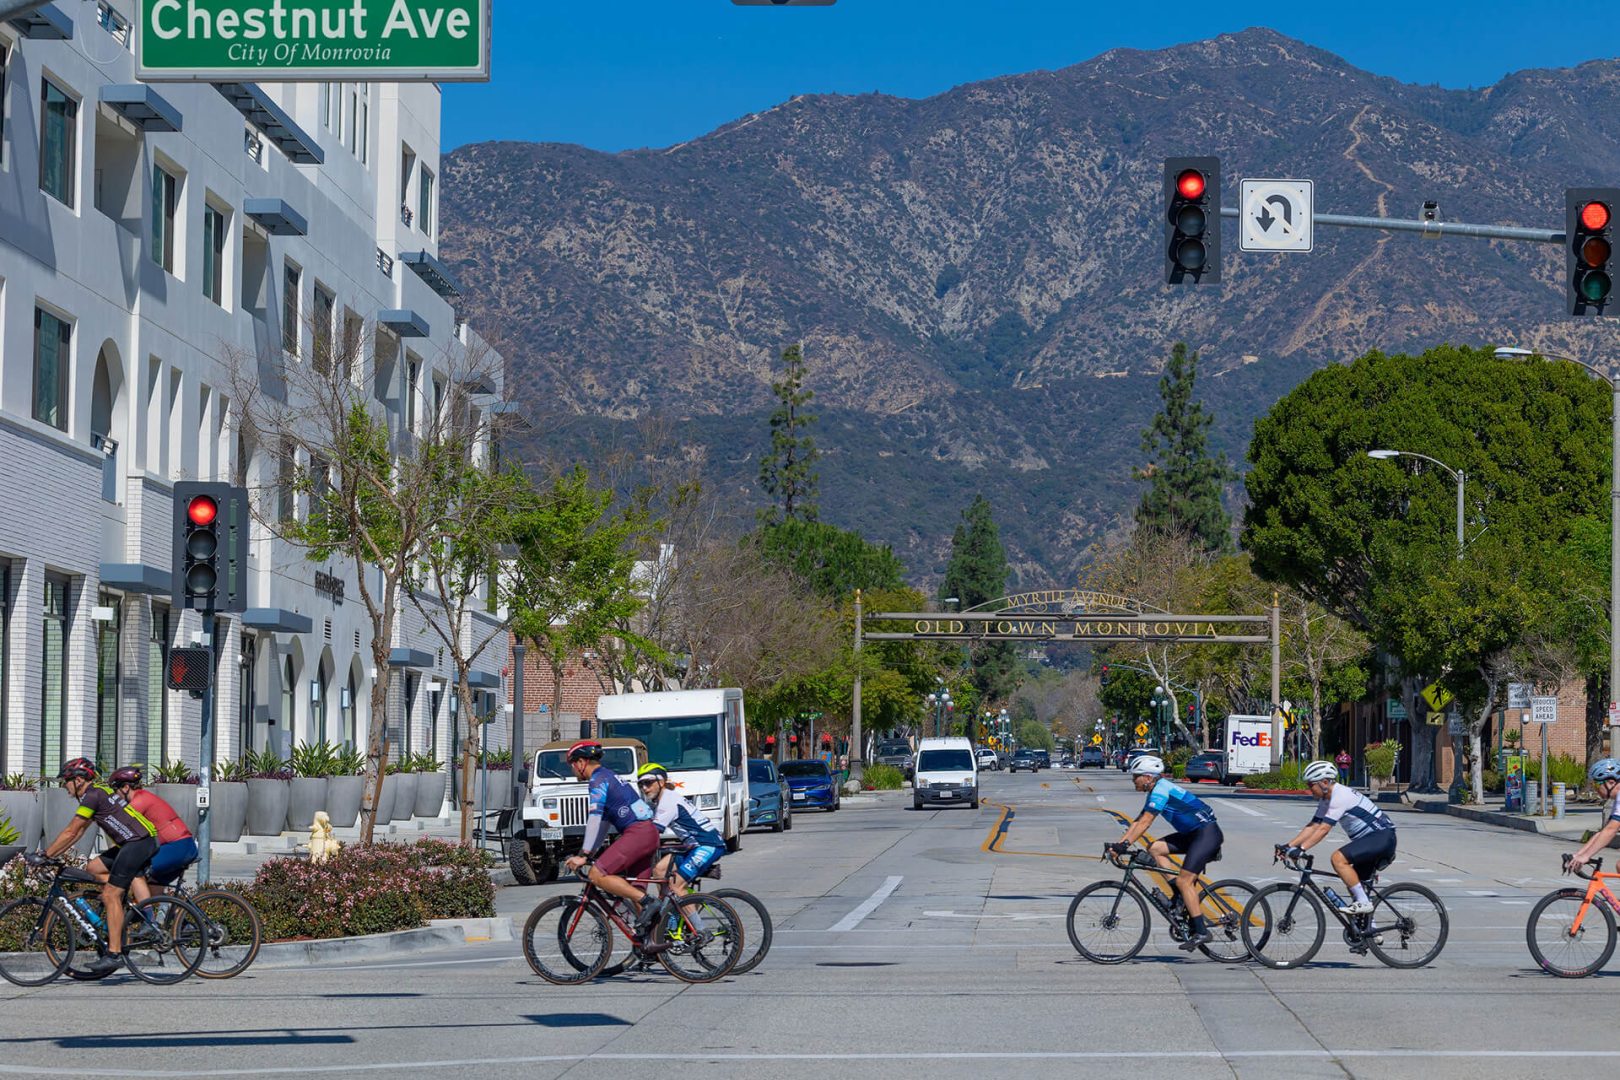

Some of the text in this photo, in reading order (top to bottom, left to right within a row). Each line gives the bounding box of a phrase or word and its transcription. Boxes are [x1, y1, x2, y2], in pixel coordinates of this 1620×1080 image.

[151, 0, 471, 40] Chestnut Ave
[227, 43, 391, 66] City Of Monrovia
[1007, 591, 1129, 609] MYRTLE AVENUE
[915, 620, 1218, 636] OLD TOWN MONROVIA
